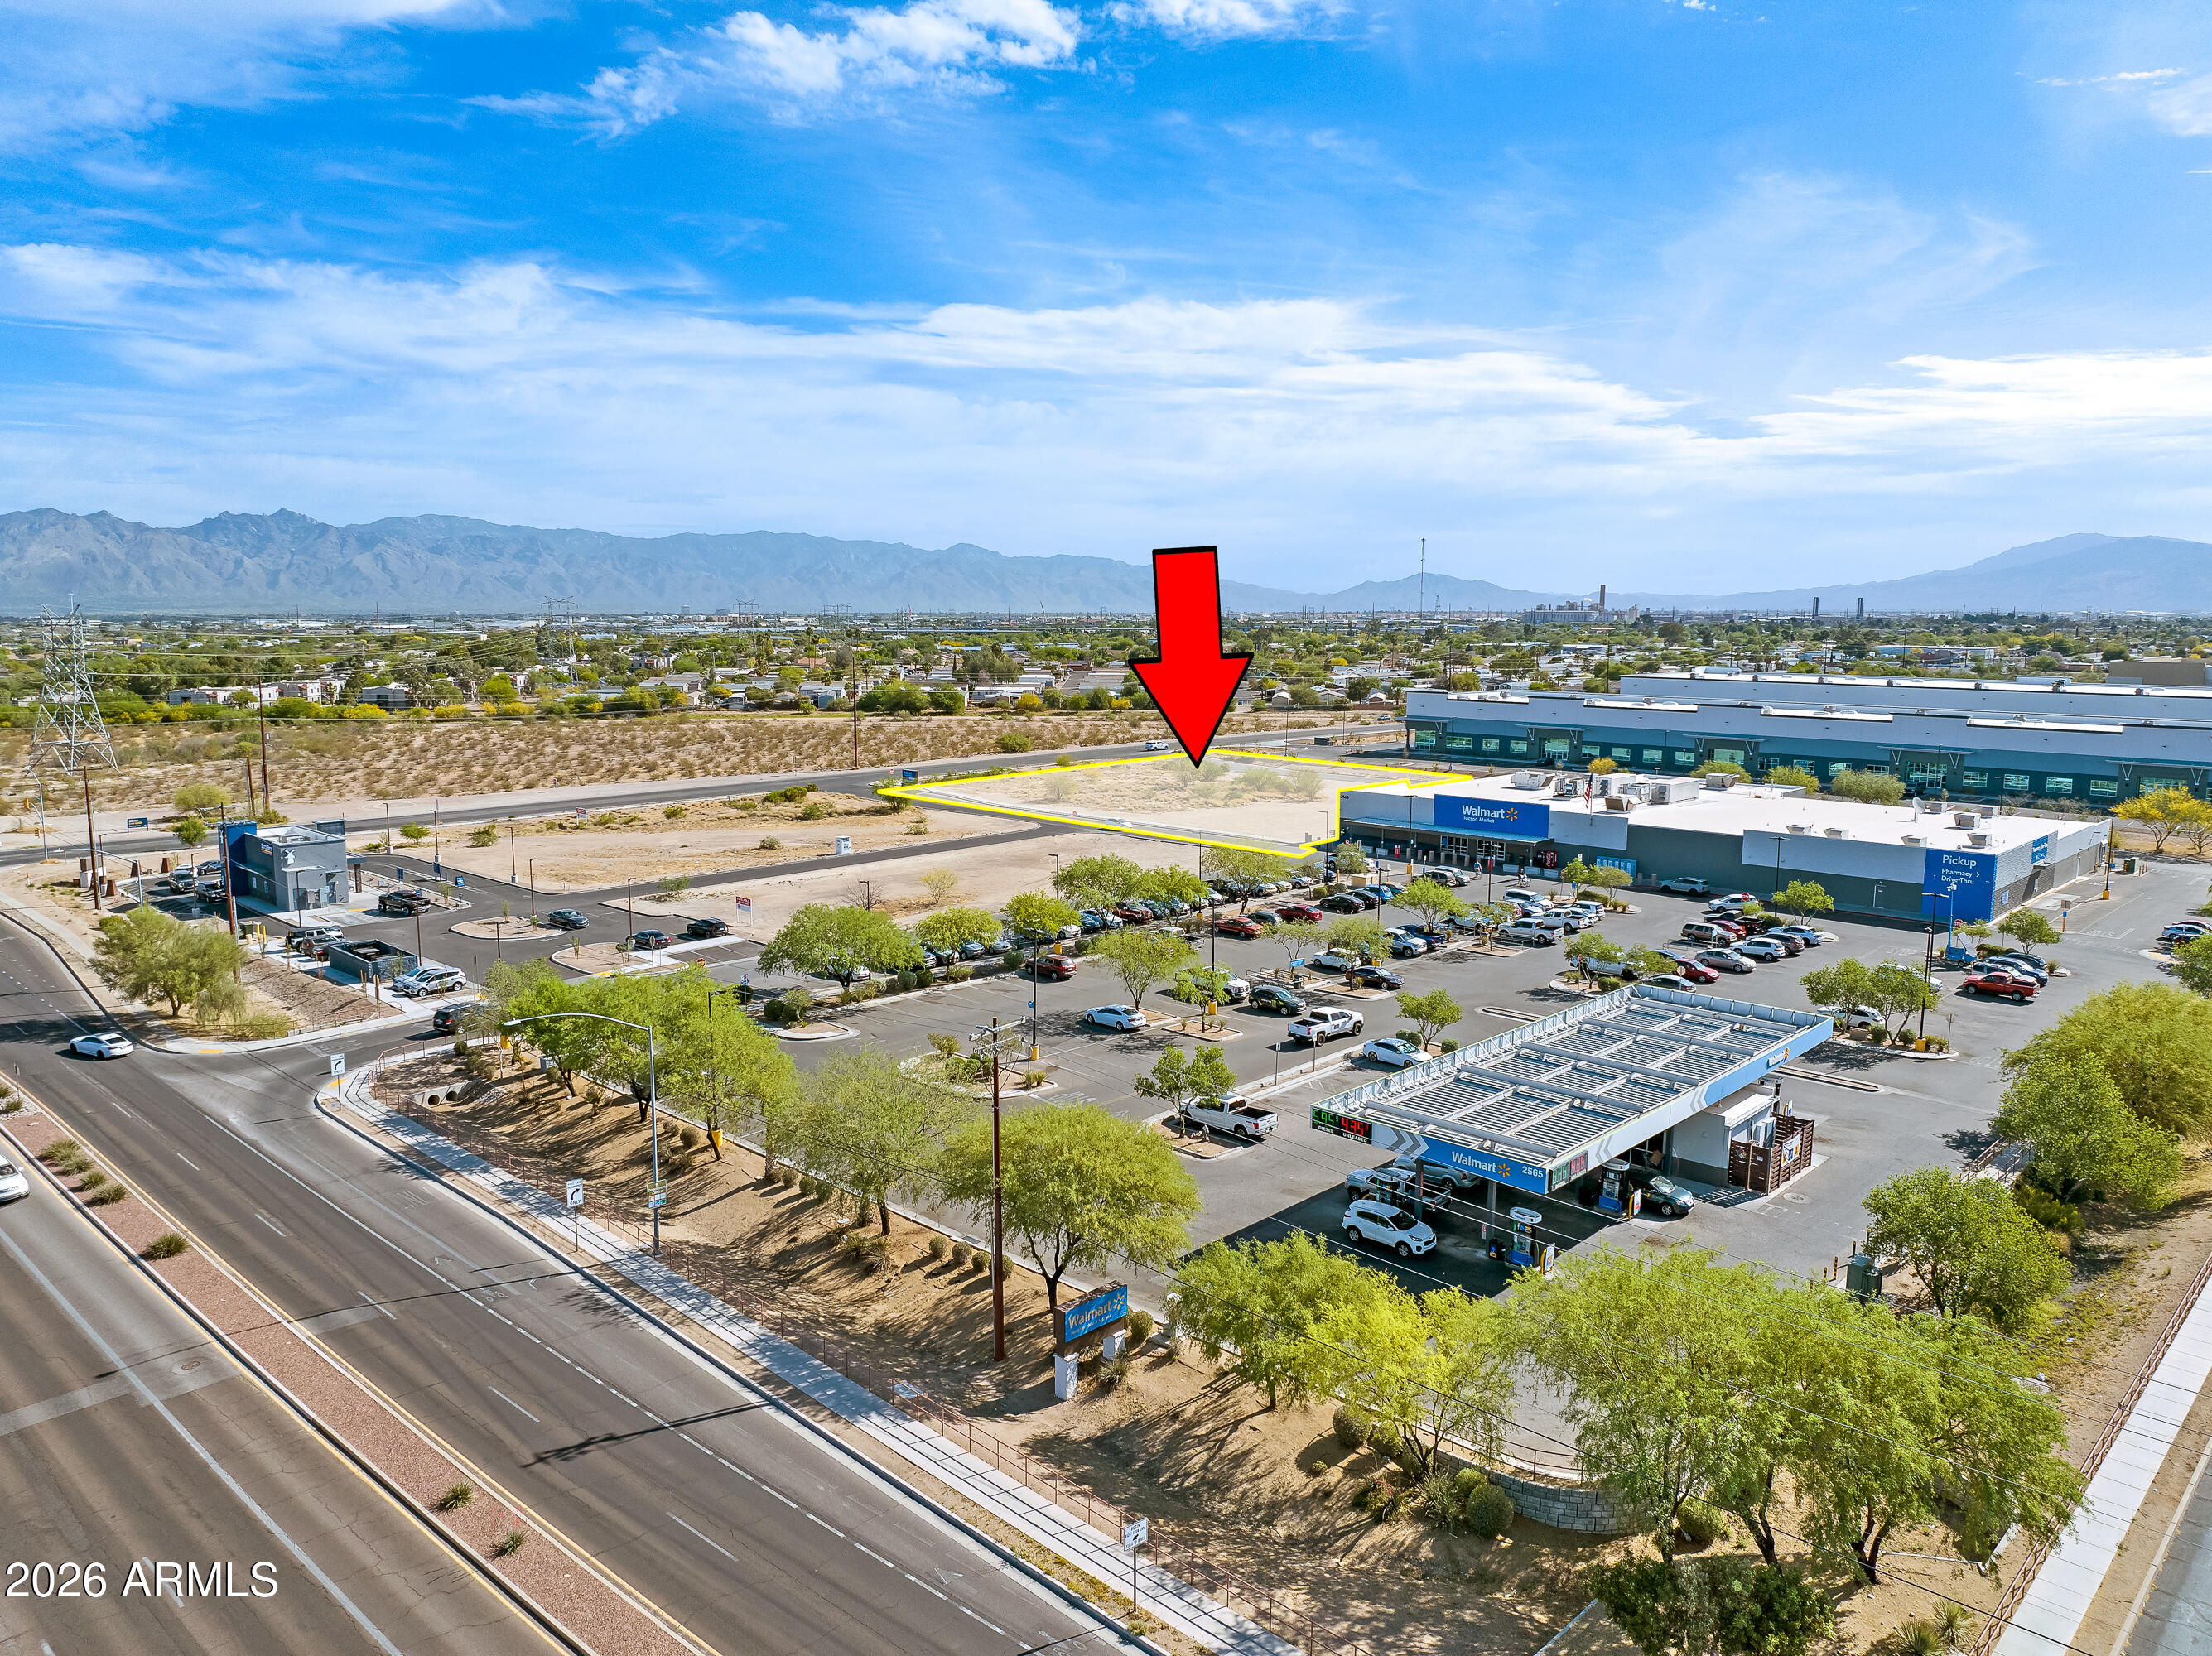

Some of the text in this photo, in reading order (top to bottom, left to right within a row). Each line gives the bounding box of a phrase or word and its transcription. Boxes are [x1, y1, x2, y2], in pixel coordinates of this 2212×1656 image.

[1462, 805, 1505, 819] Walmart
[1942, 854, 1977, 869] Pickup
[1941, 869, 1973, 879] Pharmacy
[1941, 875, 1974, 884] Drive-Thru
[1318, 1125, 1334, 1134] DIESEL
[1342, 1132, 1367, 1143] UNLEADED
[1452, 1151, 1496, 1173] Walmart
[1521, 1165, 1544, 1178] 2565
[1068, 1301, 1111, 1329] Walmart
